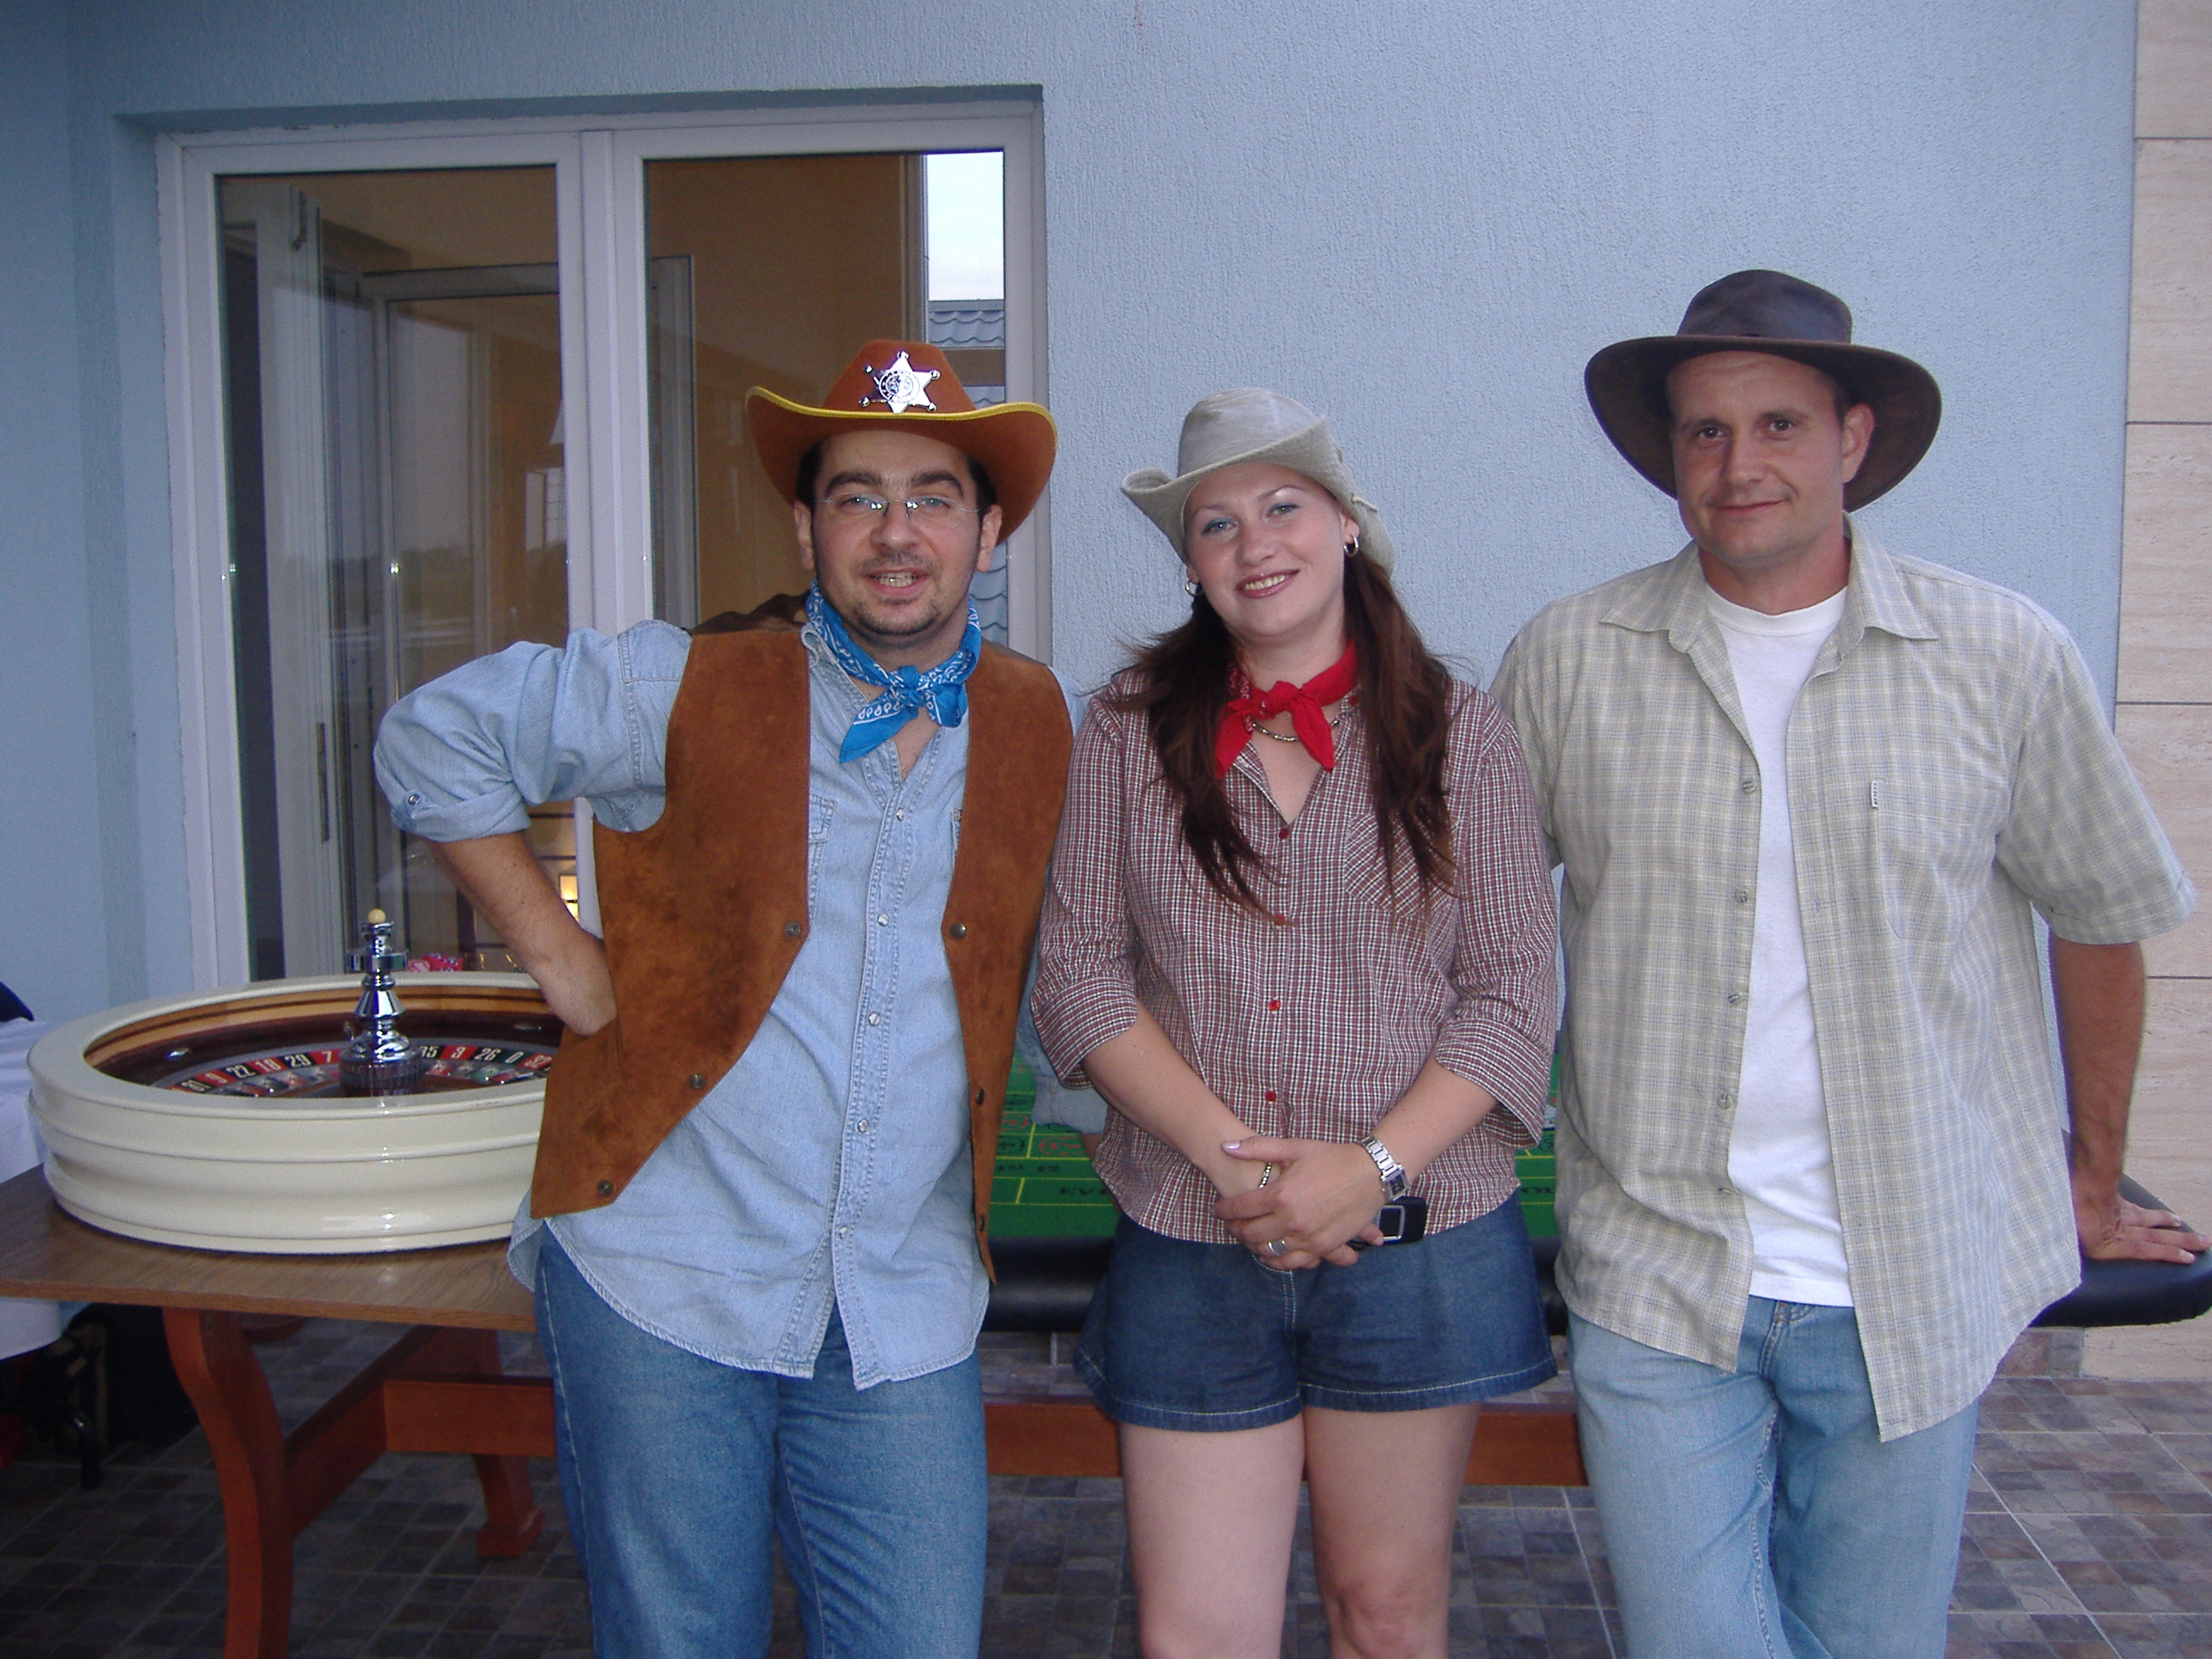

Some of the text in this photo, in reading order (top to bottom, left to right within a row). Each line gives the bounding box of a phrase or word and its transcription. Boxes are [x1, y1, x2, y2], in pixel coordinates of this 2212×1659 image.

[284, 1053, 312, 1068] 29
[322, 1051, 333, 1063] 7
[474, 1048, 502, 1062] 26
[505, 1051, 525, 1064] 0
[225, 1064, 256, 1079] 22
[255, 1058, 282, 1072] 18
